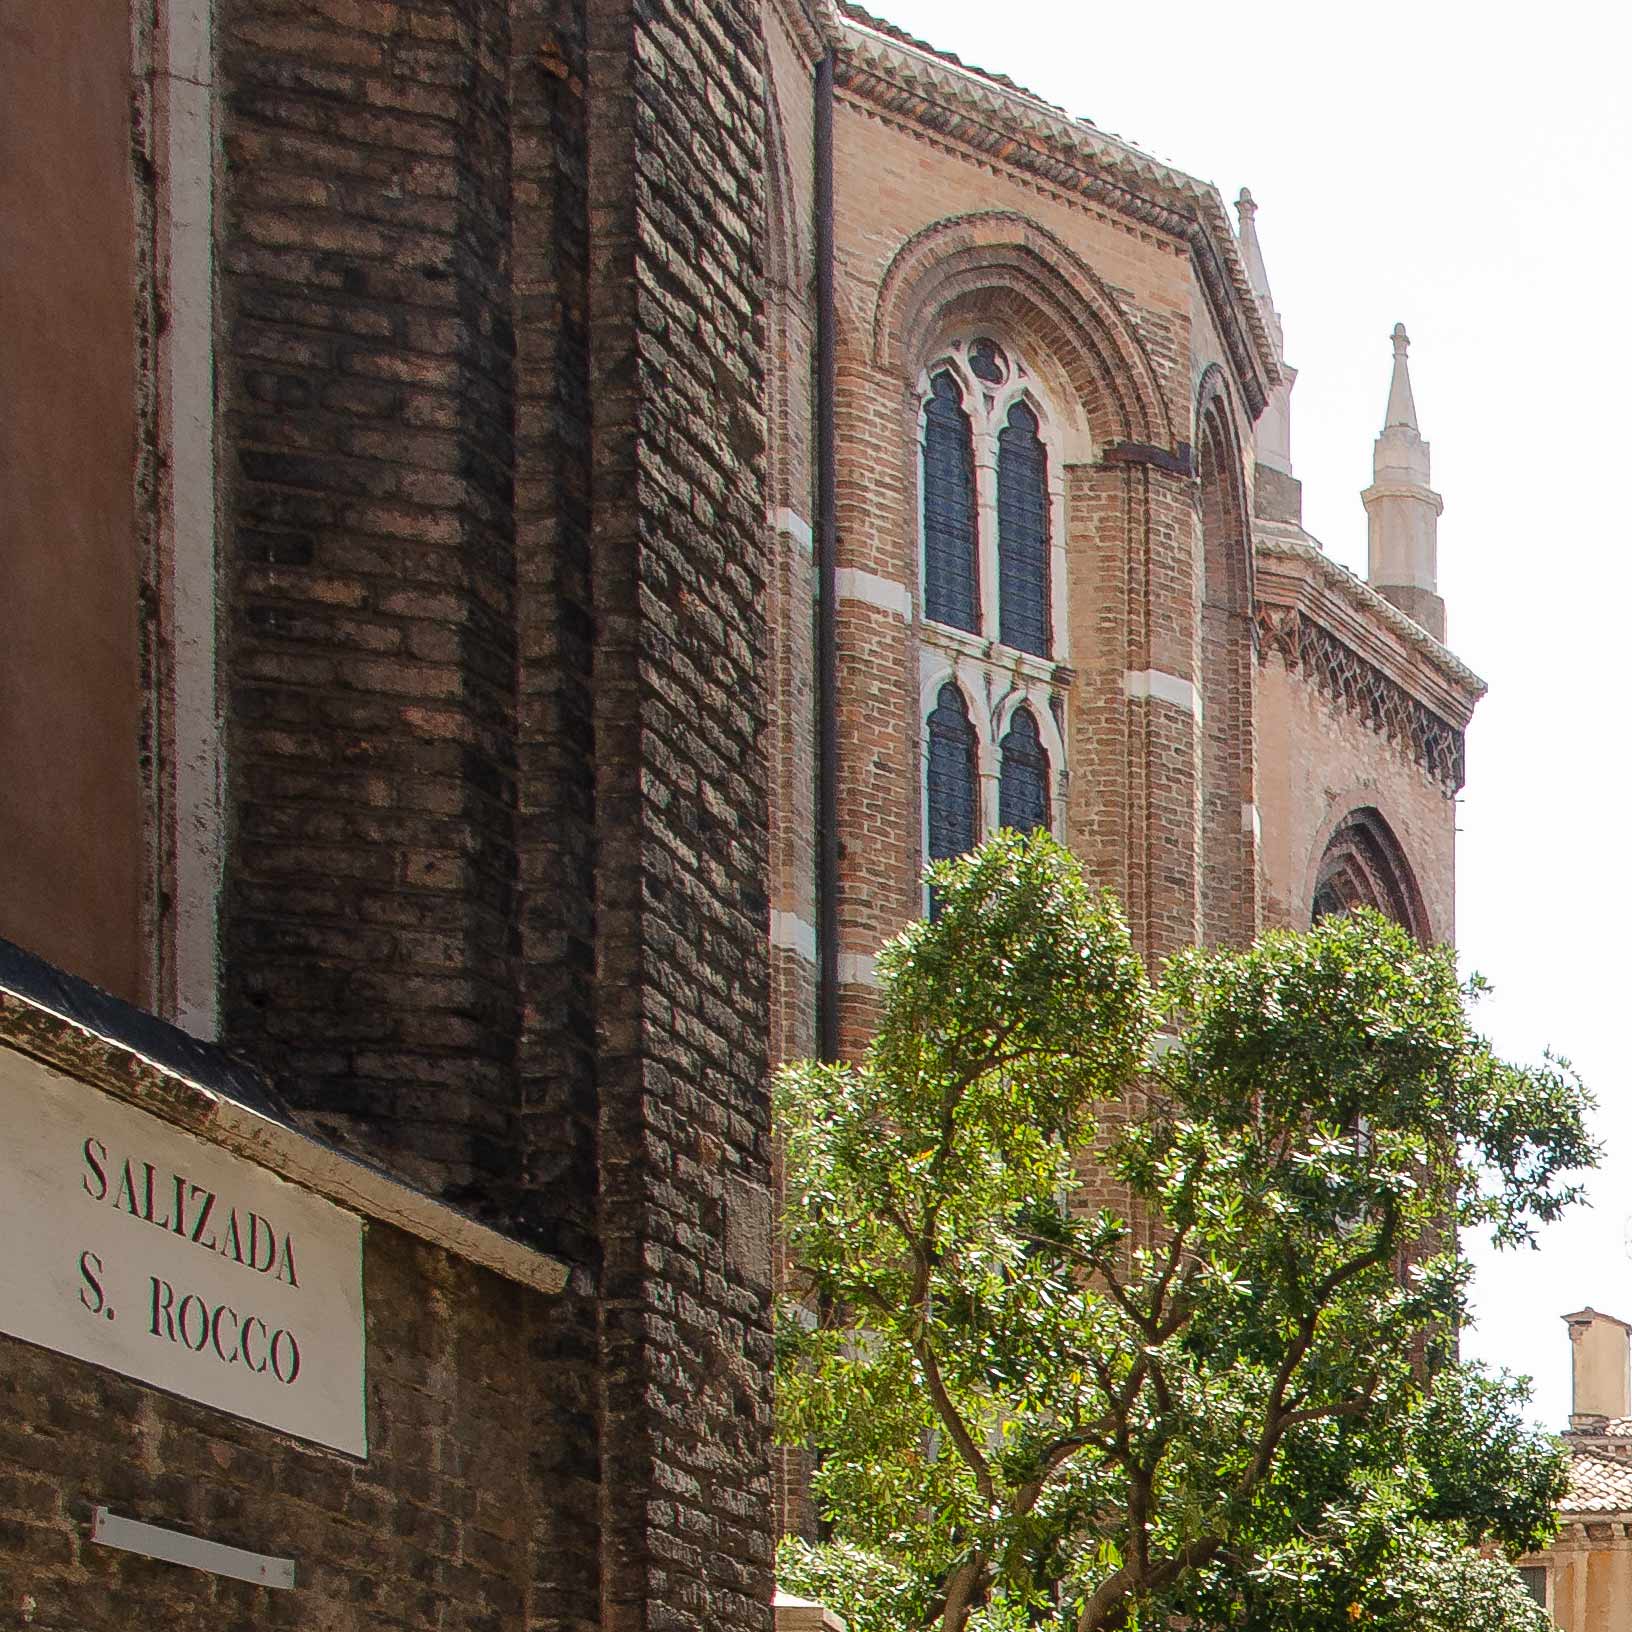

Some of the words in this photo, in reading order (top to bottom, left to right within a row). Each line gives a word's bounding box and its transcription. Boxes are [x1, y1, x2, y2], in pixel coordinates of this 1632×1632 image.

[83, 1137, 300, 1289] SALIZADA
[80, 1250, 115, 1320] S.
[149, 1276, 300, 1384] ROCCO
